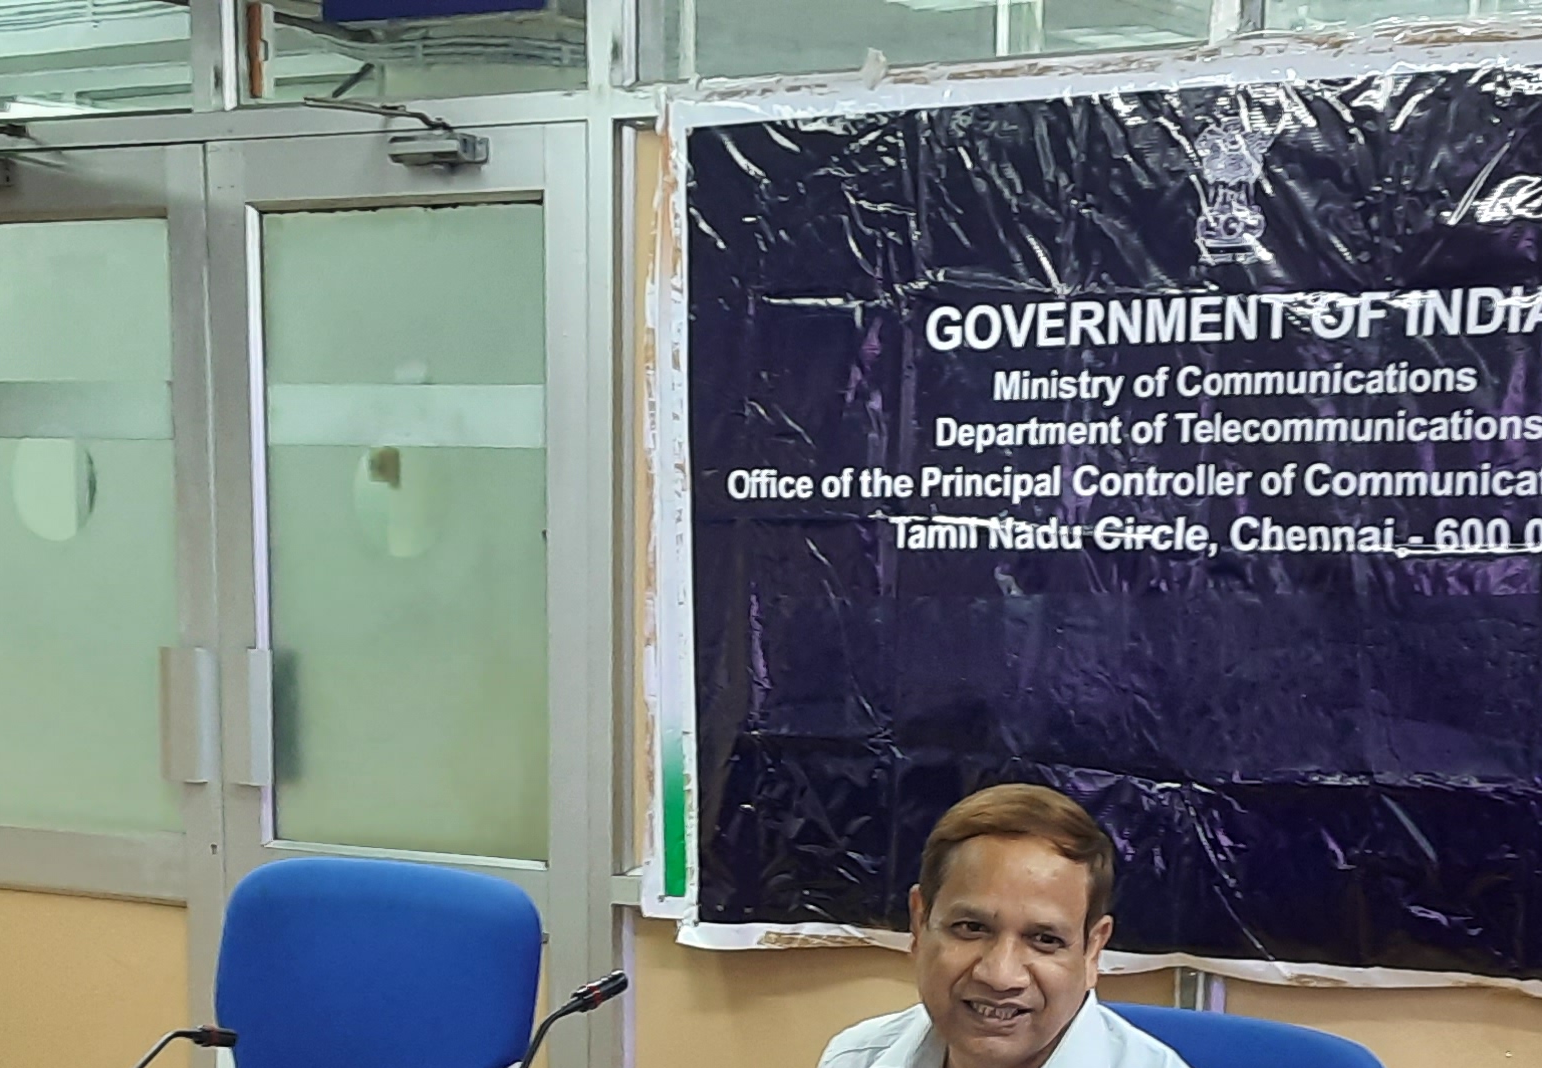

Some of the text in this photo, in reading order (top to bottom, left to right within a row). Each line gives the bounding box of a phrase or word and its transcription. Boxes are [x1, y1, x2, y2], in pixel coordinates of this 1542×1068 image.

[925, 296, 1286, 351] GOVERNMENT
[1310, 290, 1392, 341] OF
[993, 360, 1478, 406] Ministry of Communications
[935, 415, 1121, 453] Department
[1130, 413, 1166, 443] of
[727, 468, 813, 498] Office
[821, 468, 854, 497] of
[860, 468, 914, 497] the
[920, 464, 1061, 505] Principal
[1071, 463, 1253, 498] Controller
[1260, 461, 1296, 495] of
[890, 515, 978, 549] Tamil
[989, 515, 1083, 551] Nadu
[1094, 518, 1218, 557] Circle,
[1229, 518, 1394, 553] Chennai
[1433, 518, 1512, 552] 600
